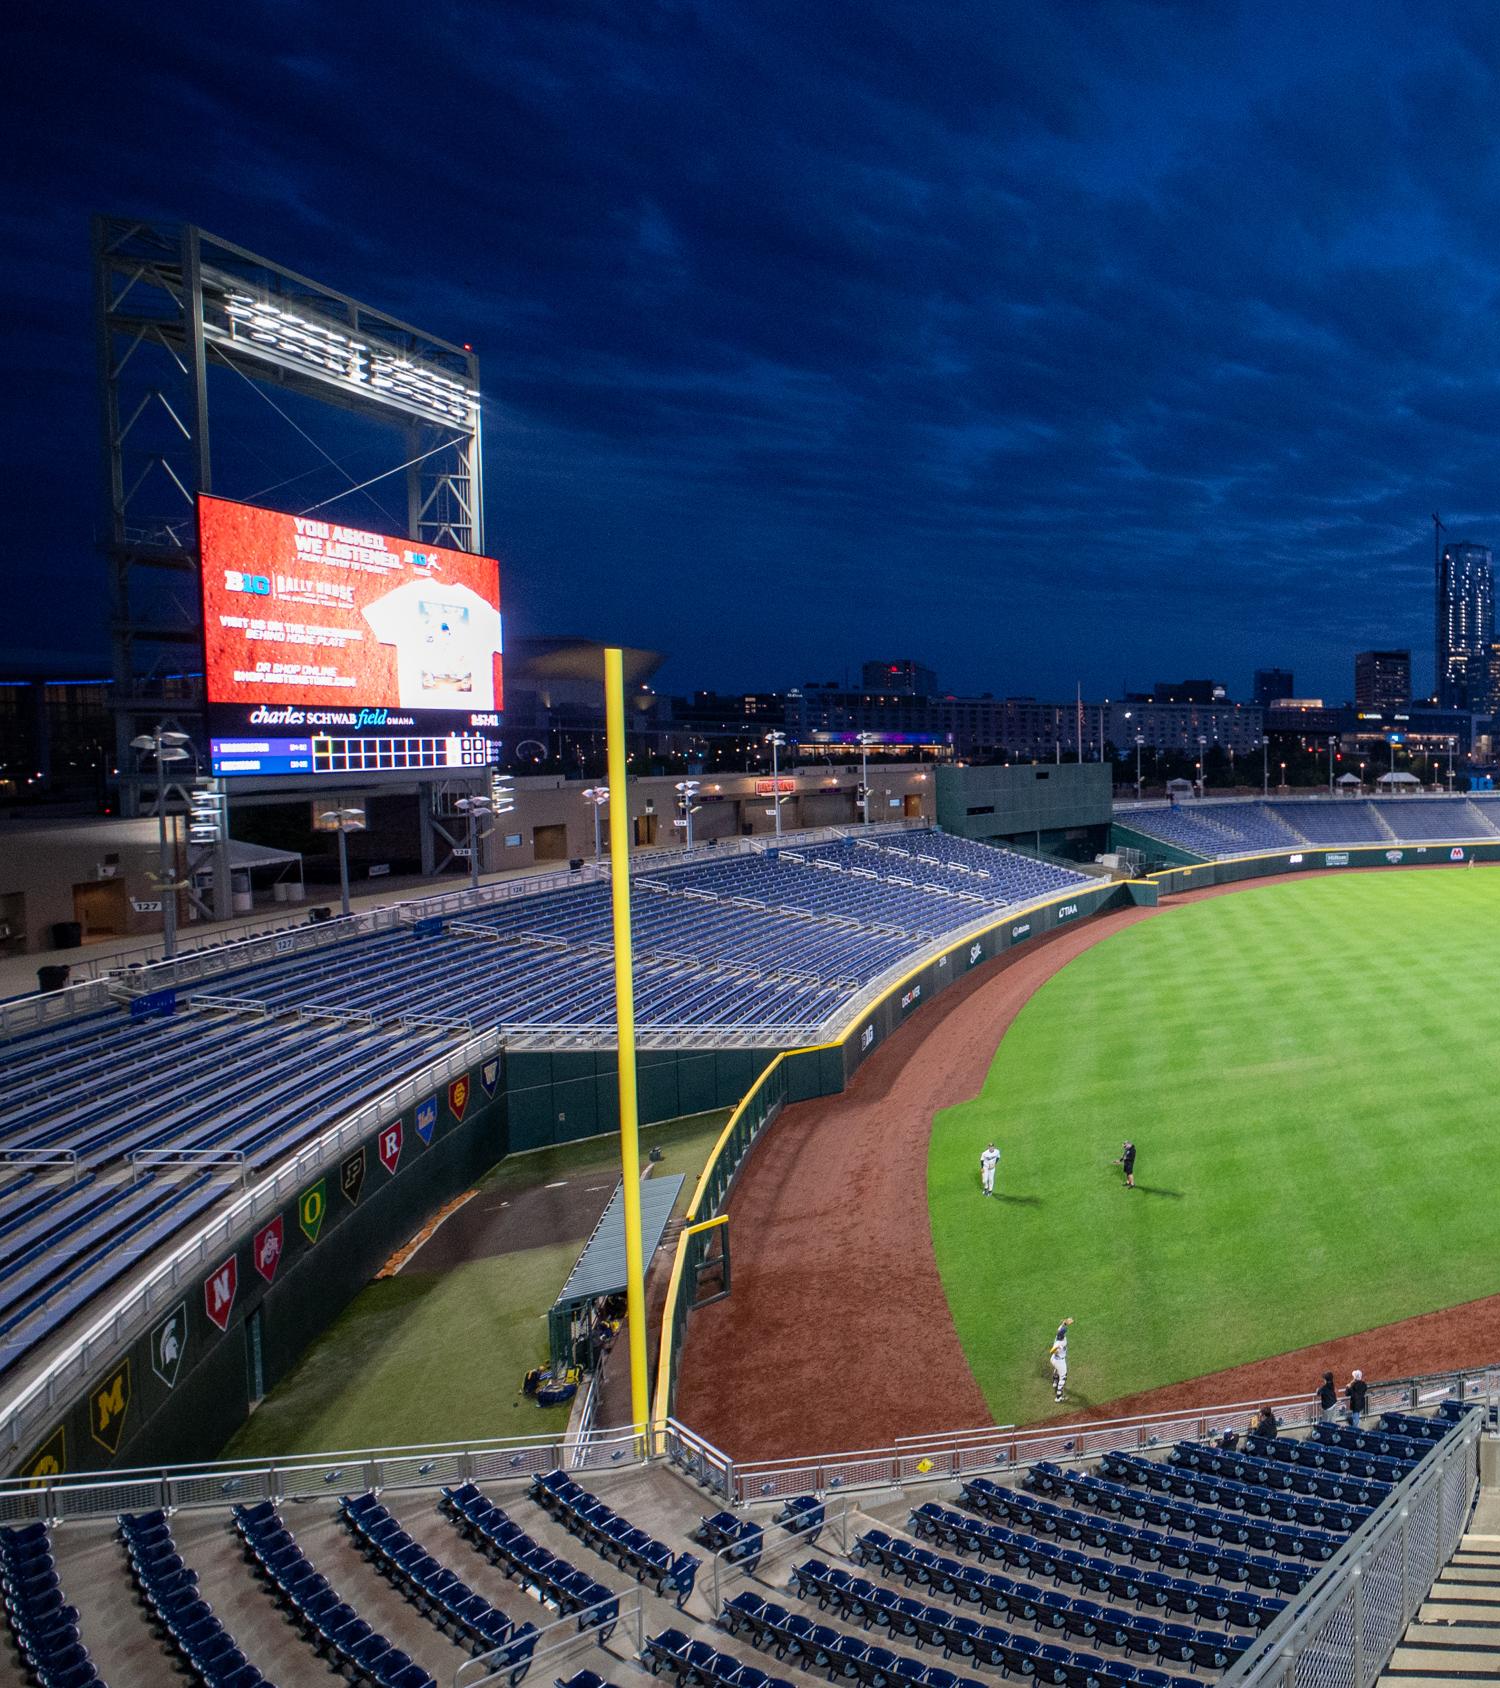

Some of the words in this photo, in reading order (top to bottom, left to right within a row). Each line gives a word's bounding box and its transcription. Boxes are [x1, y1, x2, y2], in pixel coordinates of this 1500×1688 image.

[294, 517, 329, 539] YOU
[332, 526, 387, 551] ASKED.
[294, 534, 323, 554] WE
[326, 540, 404, 570] LISTENED.
[277, 575, 314, 592] RALLY
[245, 629, 285, 642] BEHIND
[286, 633, 316, 645] HOME
[316, 635, 347, 648] PLATE
[256, 662, 272, 673] OR
[272, 663, 301, 675] SHOP
[301, 665, 338, 678] ONLINE
[250, 705, 305, 724] charles
[306, 712, 358, 725] SCHWAB
[355, 709, 388, 729] field
[386, 717, 414, 726] OMAHA
[1064, 904, 1078, 916] TIAA
[278, 940, 292, 950] 127
[484, 1061, 498, 1085] W
[385, 1132, 398, 1159] R
[345, 1157, 362, 1190] P
[304, 1192, 321, 1224] O
[213, 1269, 231, 1312] N
[98, 1375, 125, 1431] M
